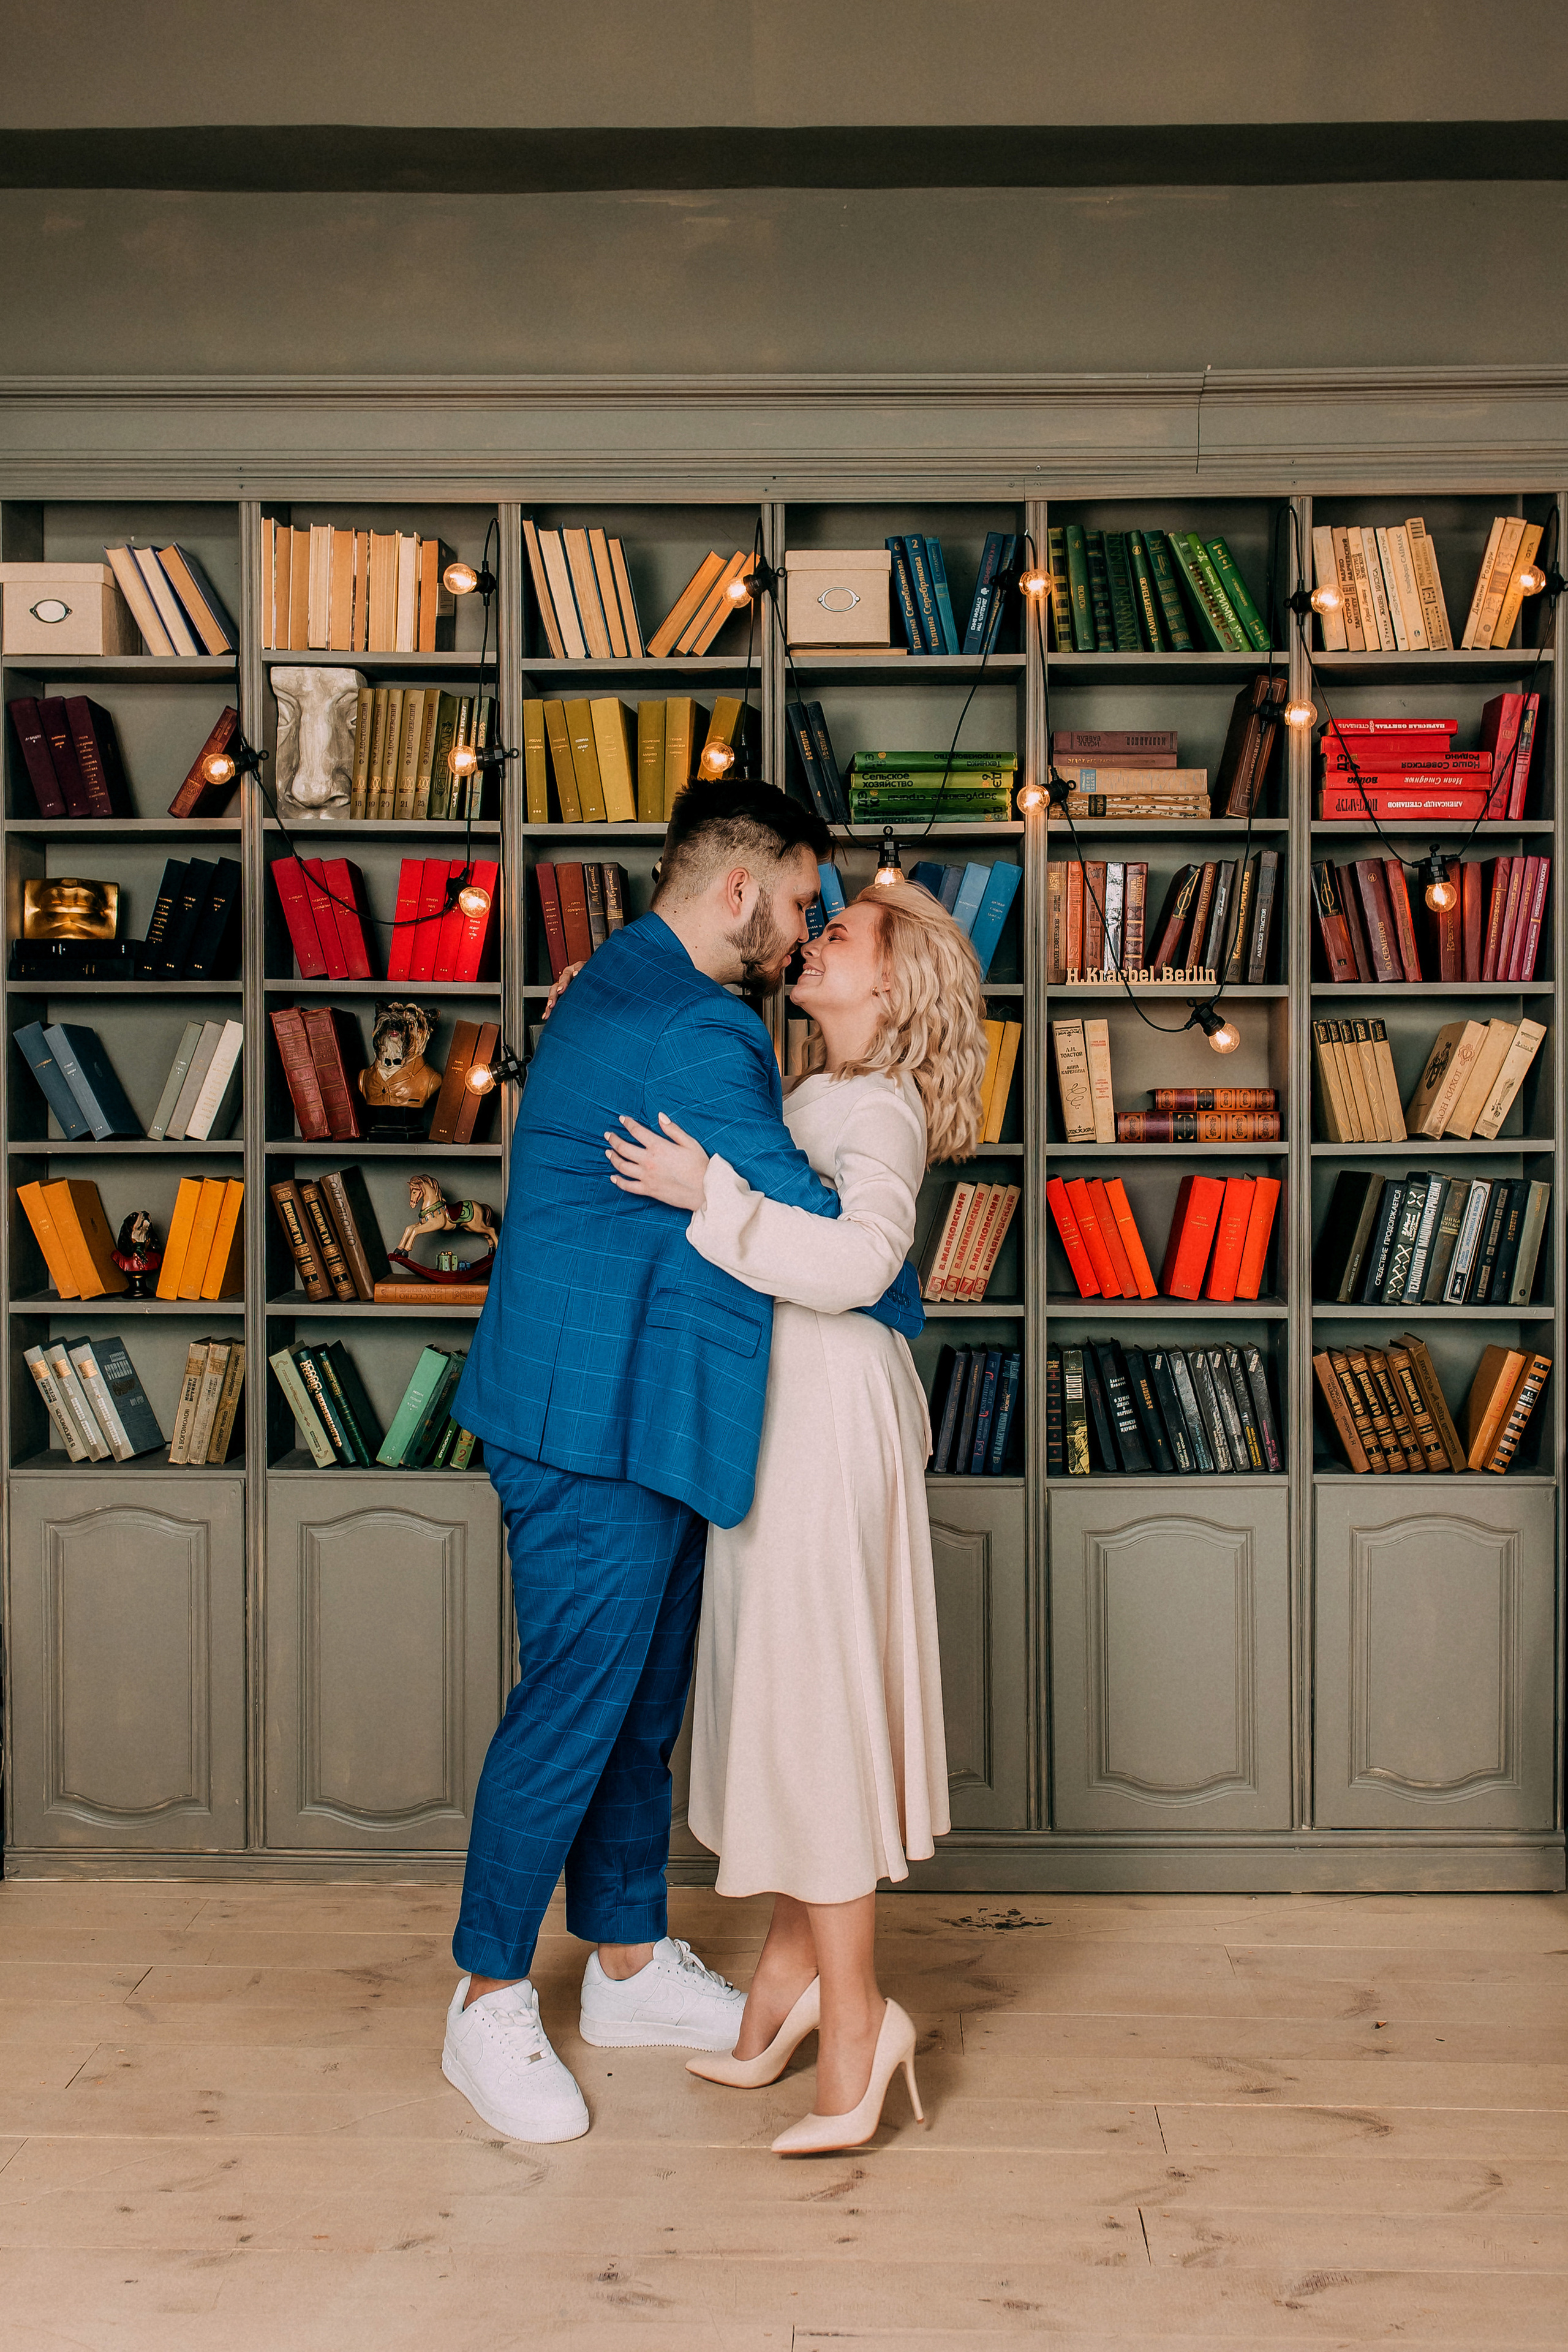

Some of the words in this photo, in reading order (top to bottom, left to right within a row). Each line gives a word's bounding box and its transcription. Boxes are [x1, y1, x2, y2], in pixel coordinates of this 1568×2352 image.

[911, 539, 919, 548] 2
[1343, 538, 1353, 581] МАРЧЕВСКИЙ
[897, 560, 914, 617] Серебрякова
[915, 557, 932, 614] Серебрякова
[1472, 585, 1485, 615] Джанни
[1482, 551, 1494, 579] Родари
[1214, 587, 1236, 622] ГРИММ
[910, 619, 921, 649] Галина
[927, 617, 939, 646] Галина
[1231, 964, 1240, 976] 2
[1437, 1101, 1451, 1124] ДОН
[1445, 1069, 1463, 1102] КИХОТ
[939, 1193, 967, 1270] В.МАЯКОВСКИЙ
[954, 1192, 984, 1269] В.МАЯКОВСКИЙ
[969, 1194, 1000, 1271] В.МАЯКОВСКИЙ
[983, 1195, 1015, 1272] В.МАЯКОВСКИЙ
[1374, 1247, 1389, 1286] СЛЕДСТВИЕ
[1384, 1189, 1402, 1246] ПРОДОЛЖАЕТСЯ
[1408, 1248, 1428, 1294] ТЕХНОЛОГИЯ
[1419, 1181, 1442, 1248] МАШИНОСТРОЕНИЯ
[1466, 1217, 1476, 1246] ЖЕНЩИНА
[933, 1278, 942, 1292] 5
[947, 1278, 957, 1289] 6
[963, 1279, 973, 1292] 7
[975, 1279, 986, 1292] 8
[184, 1378, 193, 1401] МОМЕНТ
[1066, 1374, 1083, 1400] ИДИОТ
[1420, 1360, 1433, 1390] ФАРАОН
[56, 1408, 74, 1444] БОГОМОЛОВ
[179, 1409, 190, 1445] БОГОМОЛОВ
[457, 1449, 467, 1462] 2
